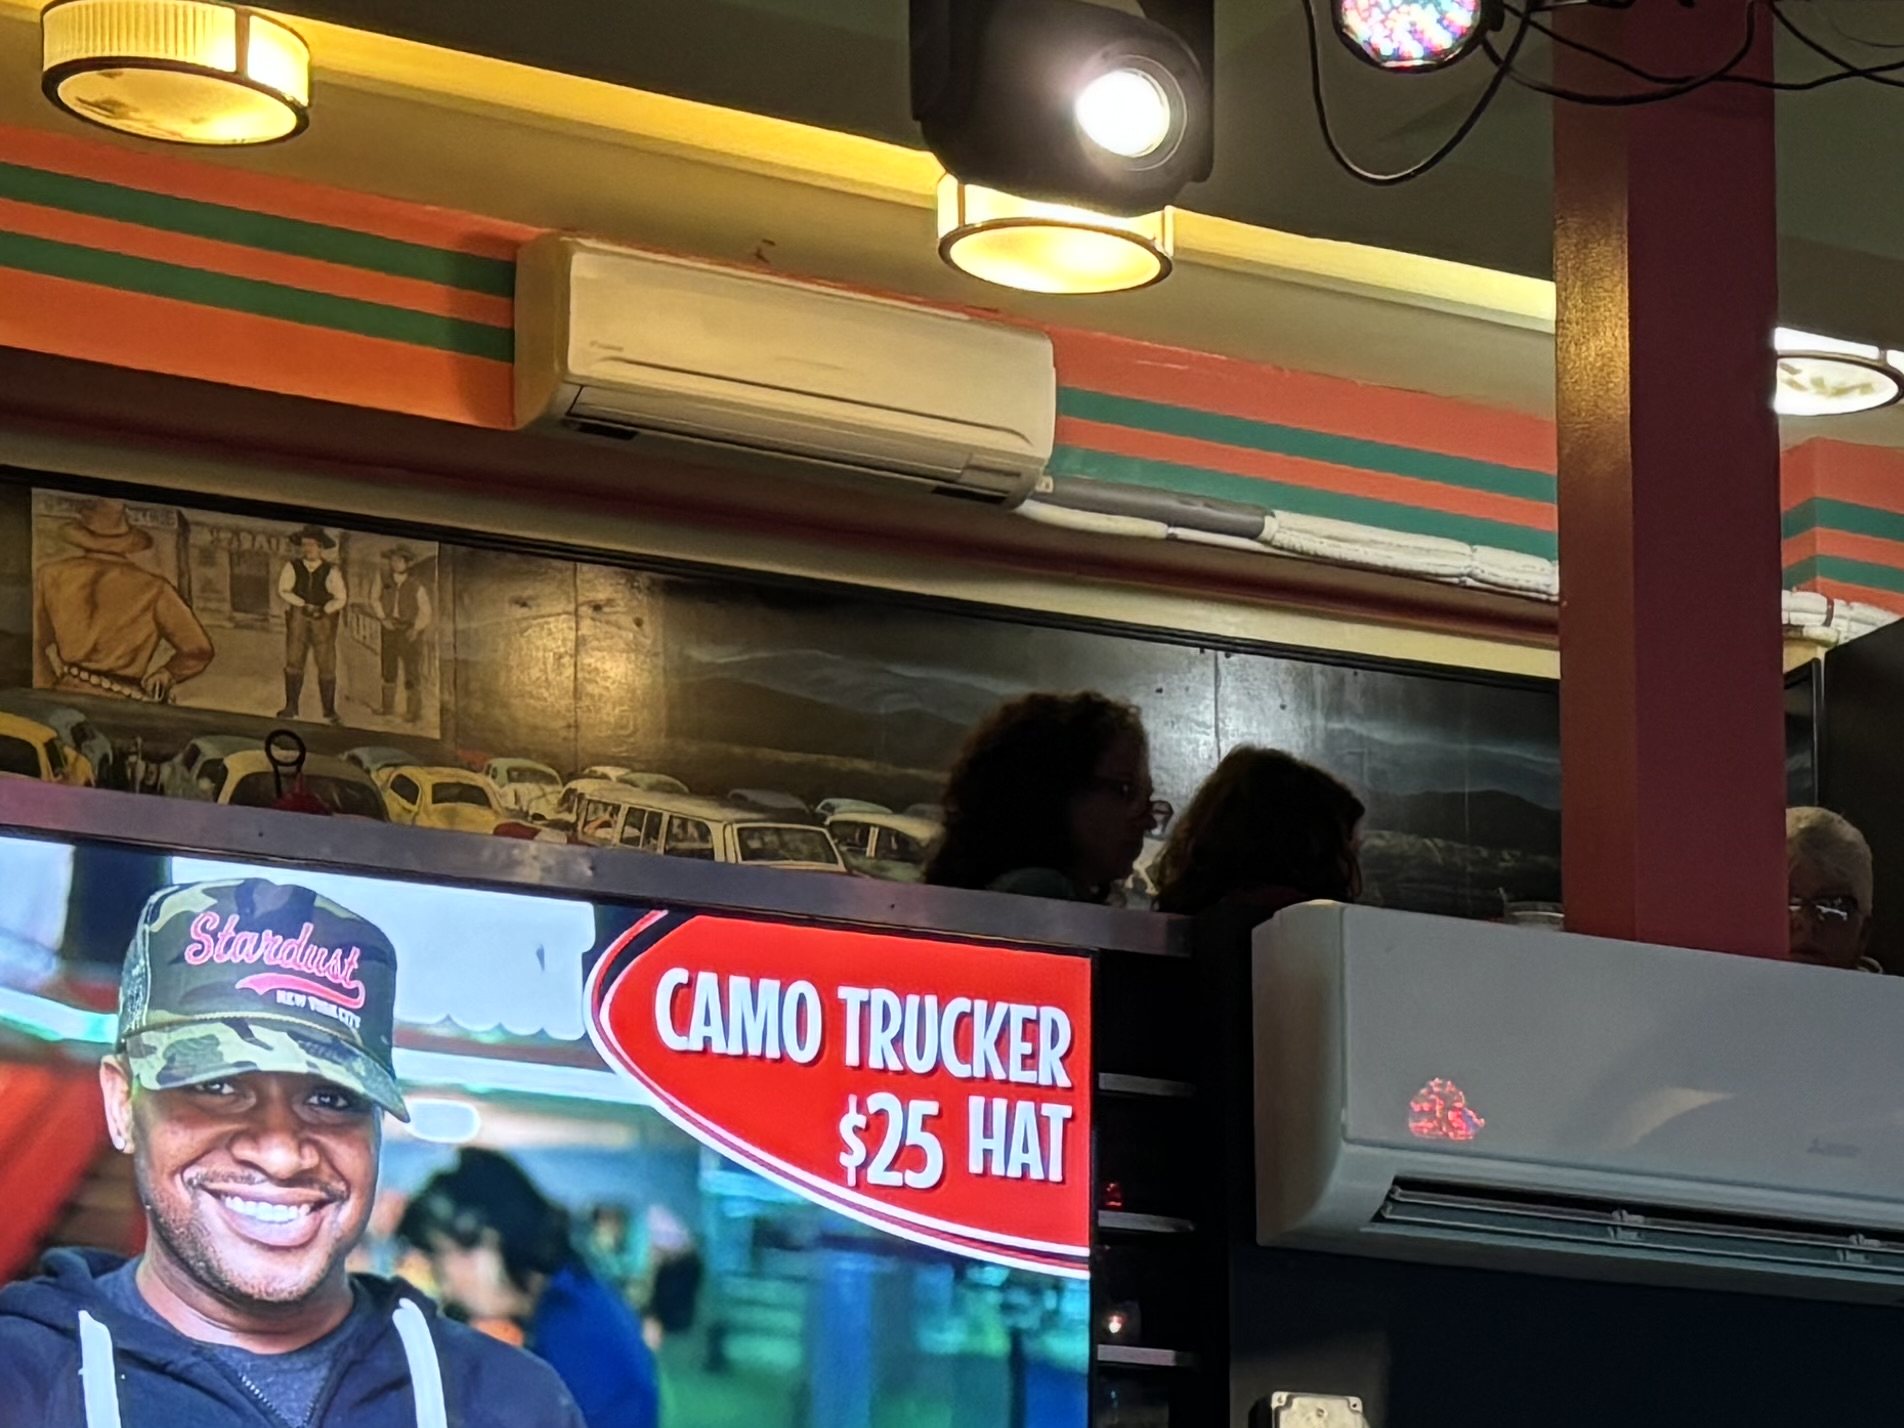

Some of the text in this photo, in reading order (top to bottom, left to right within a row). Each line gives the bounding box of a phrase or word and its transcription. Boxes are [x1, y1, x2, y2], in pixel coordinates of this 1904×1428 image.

[185, 911, 366, 988] Stardust
[655, 967, 1073, 1089] CAMO TRUCKER
[838, 1092, 1074, 1189] $25 HAT
